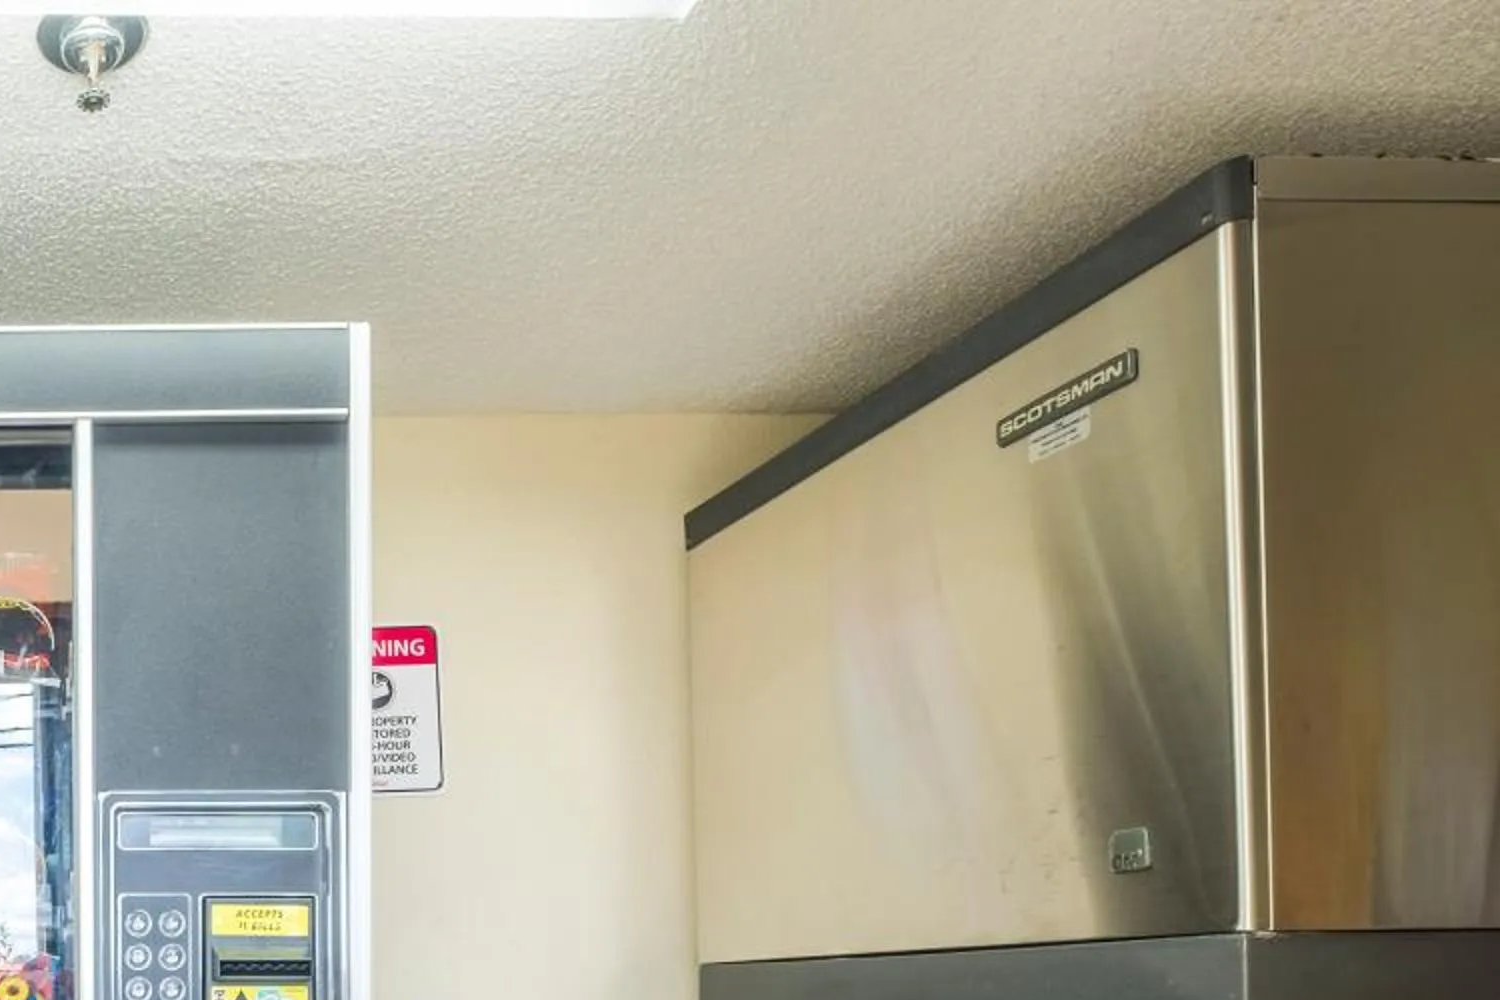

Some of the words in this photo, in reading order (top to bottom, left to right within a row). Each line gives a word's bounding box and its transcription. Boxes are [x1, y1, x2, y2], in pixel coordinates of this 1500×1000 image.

[1000, 360, 1124, 439] SCOTSMAN
[372, 637, 426, 658] NING
[372, 715, 418, 727] OPERTY
[373, 727, 411, 740] TORED
[372, 739, 411, 751] -HOUR
[373, 763, 419, 776] ILLANCE
